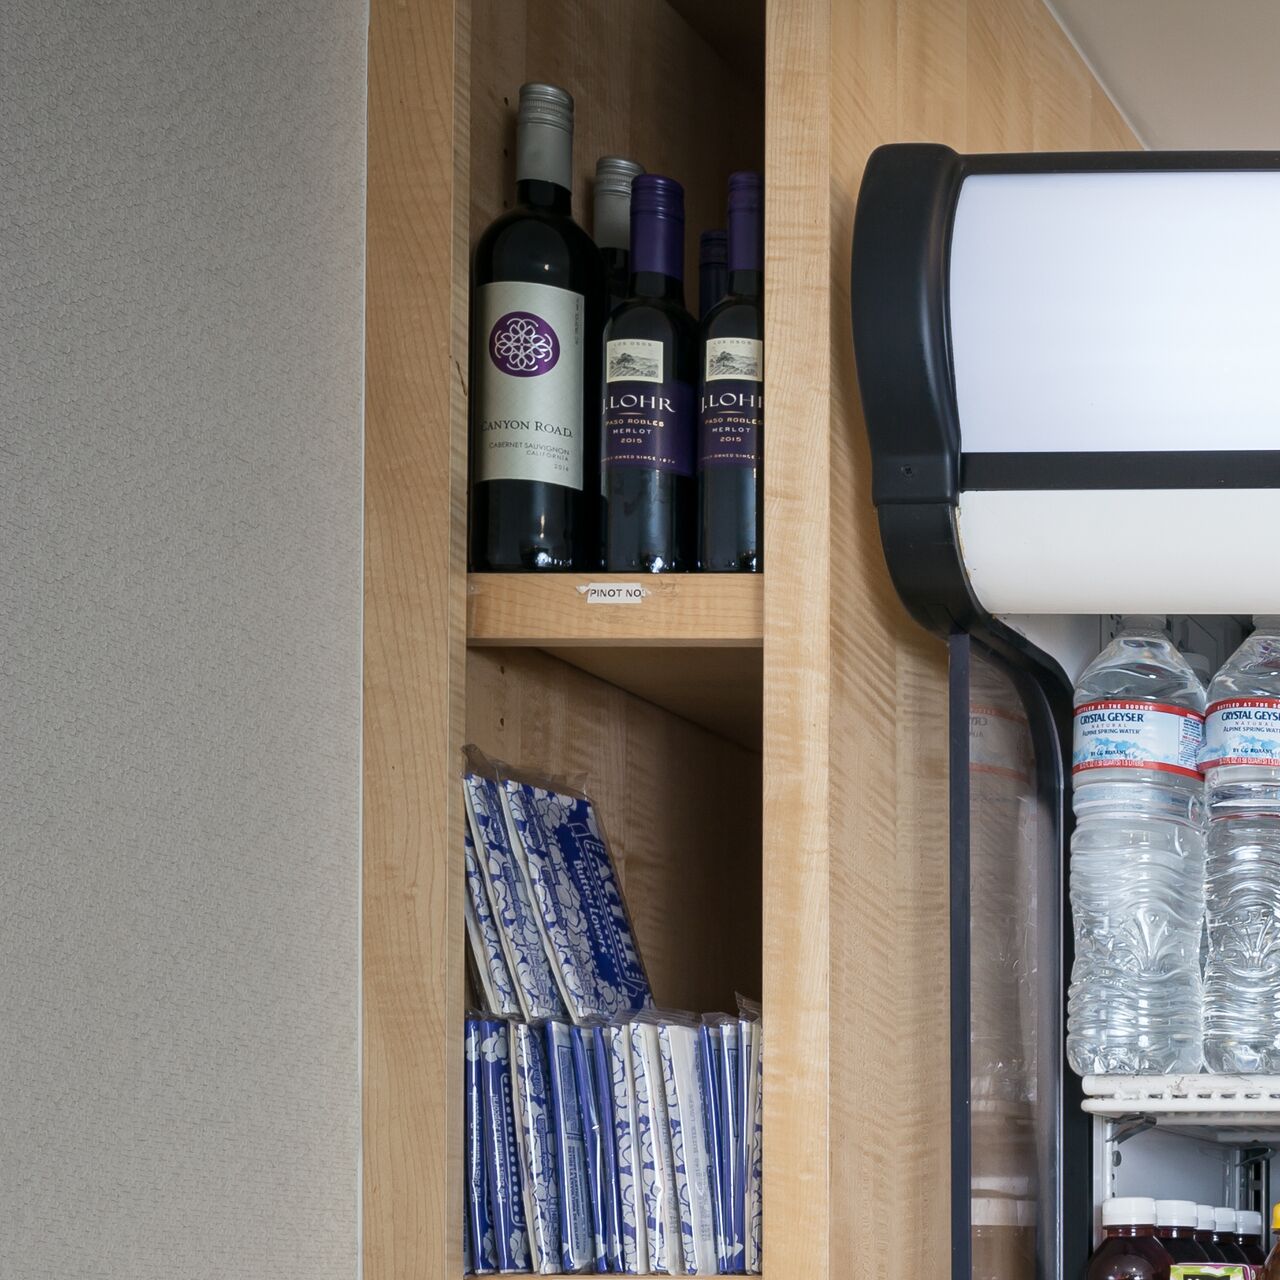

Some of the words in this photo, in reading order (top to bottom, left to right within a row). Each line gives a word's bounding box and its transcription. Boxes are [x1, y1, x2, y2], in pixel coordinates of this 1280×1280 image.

[602, 394, 676, 415] J.LOHR
[489, 441, 523, 450] CABERNET
[590, 588, 621, 599] PINOT
[1221, 711, 1252, 722] CRYSTAL
[1243, 726, 1264, 734] SPRING
[572, 859, 596, 905] Butter
